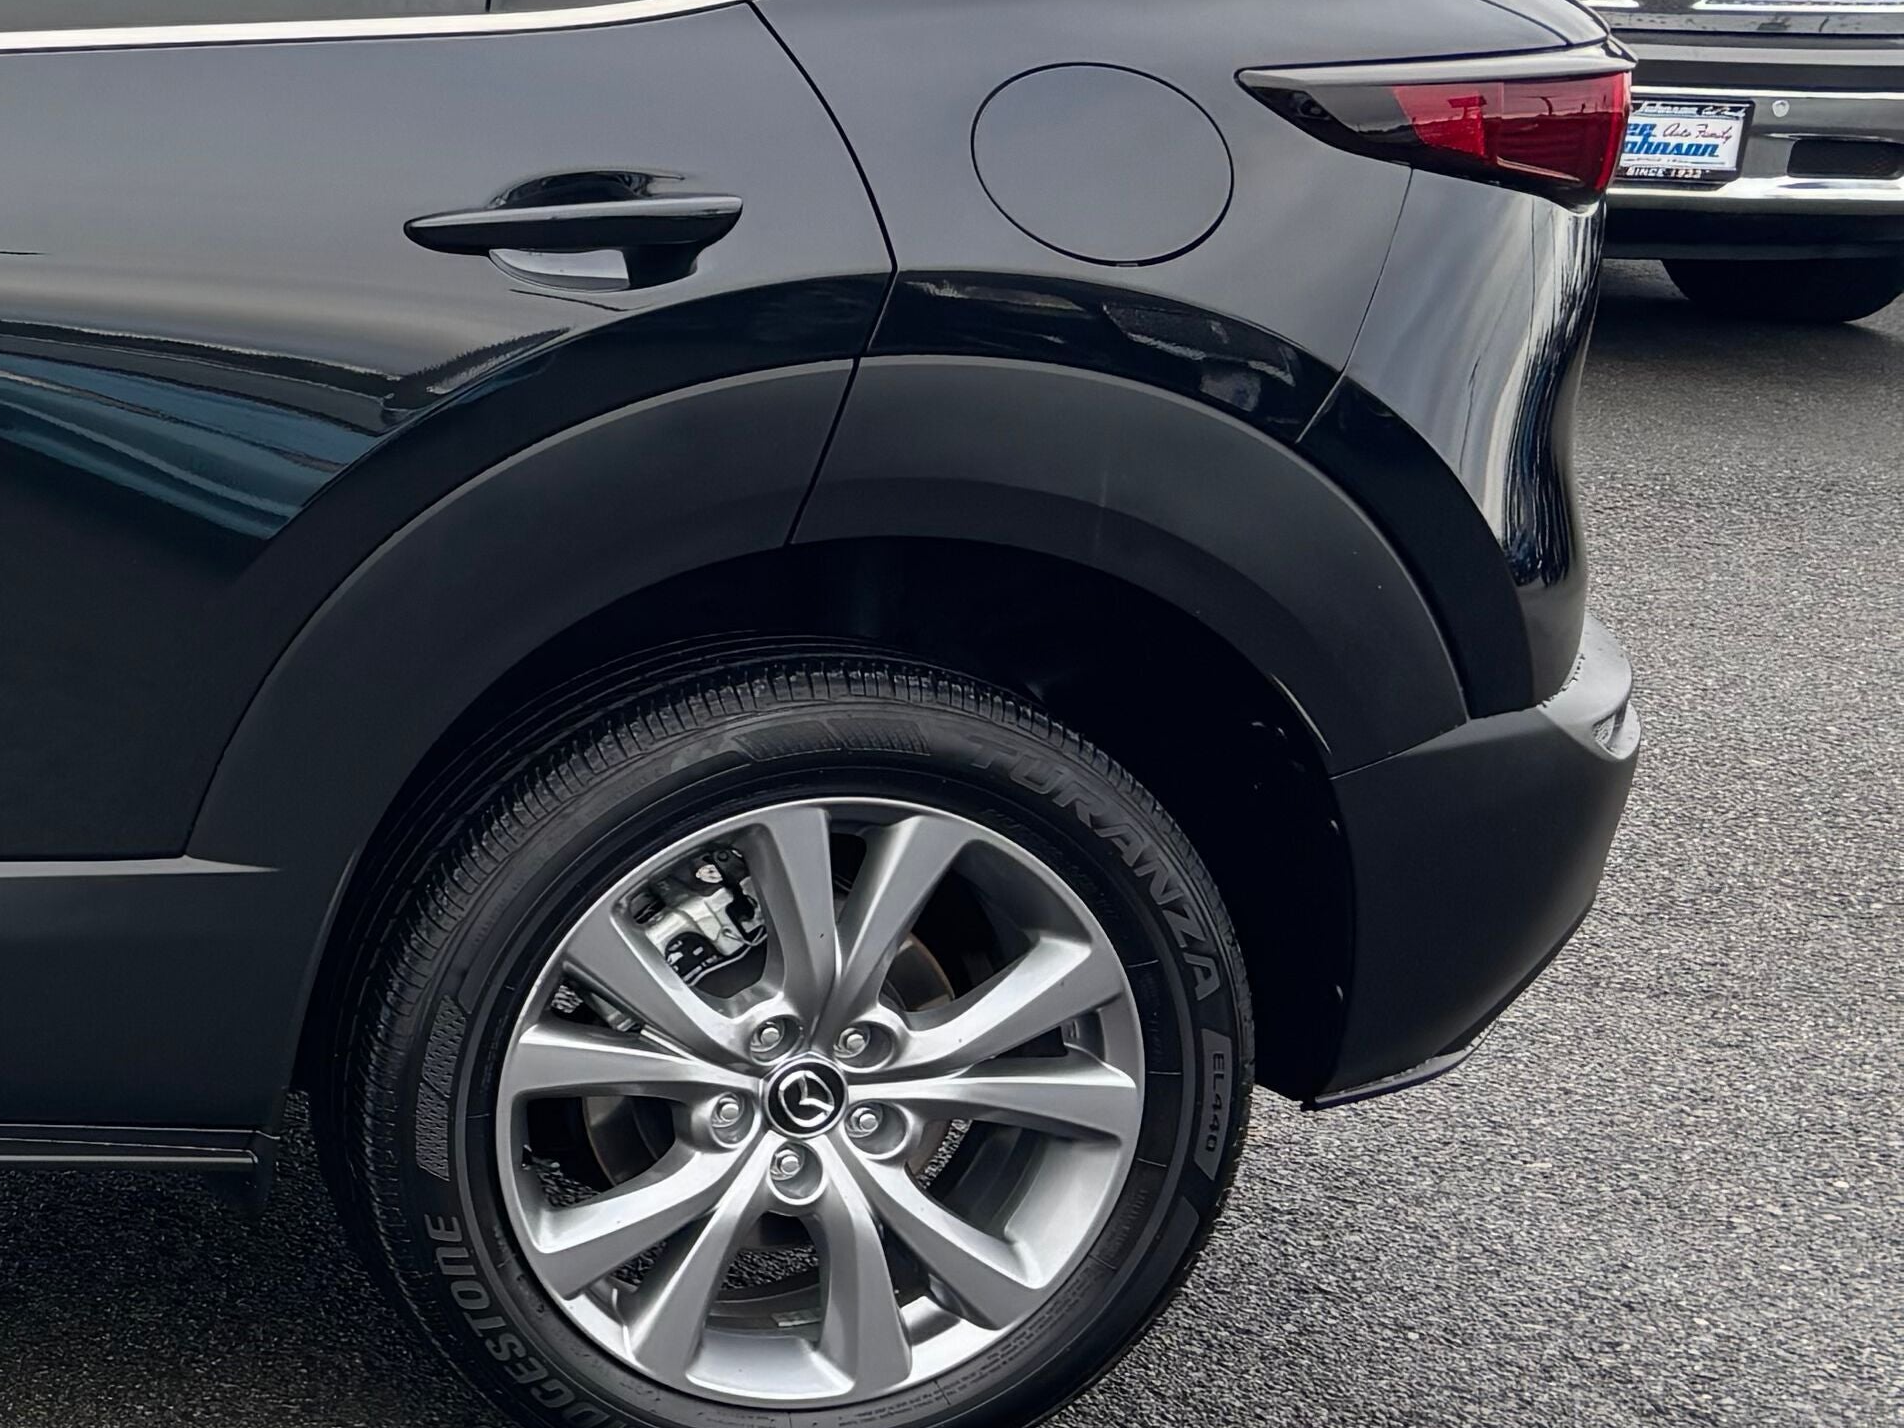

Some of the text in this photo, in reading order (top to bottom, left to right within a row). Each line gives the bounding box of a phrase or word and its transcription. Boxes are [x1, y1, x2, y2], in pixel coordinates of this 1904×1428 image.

[1624, 134, 1721, 158] ohnson
[1662, 122, 1692, 138] Auto
[968, 741, 1222, 1002] TURANZA
[1204, 1051, 1227, 1154] EL440
